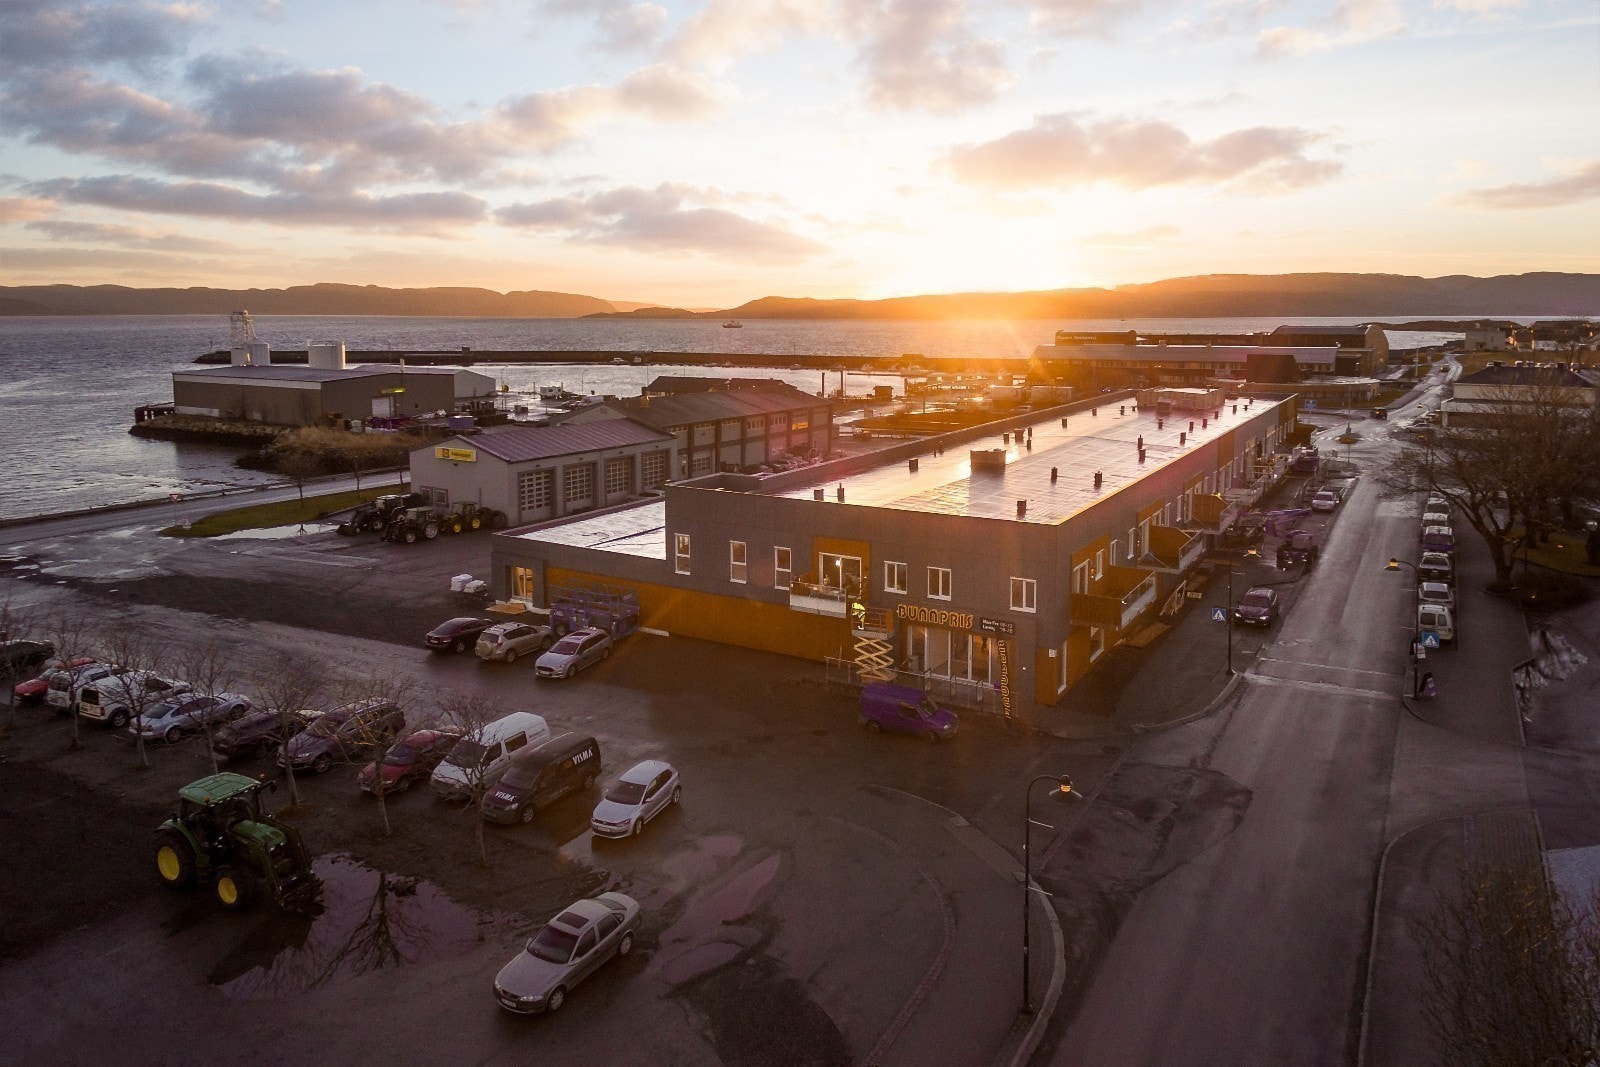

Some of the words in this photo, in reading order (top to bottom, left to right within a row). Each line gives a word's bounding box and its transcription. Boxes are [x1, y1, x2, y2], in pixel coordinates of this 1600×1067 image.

[897, 604, 974, 629] BUNNPRIS
[572, 748, 593, 765] VISMA
[494, 791, 514, 802] VISMA
